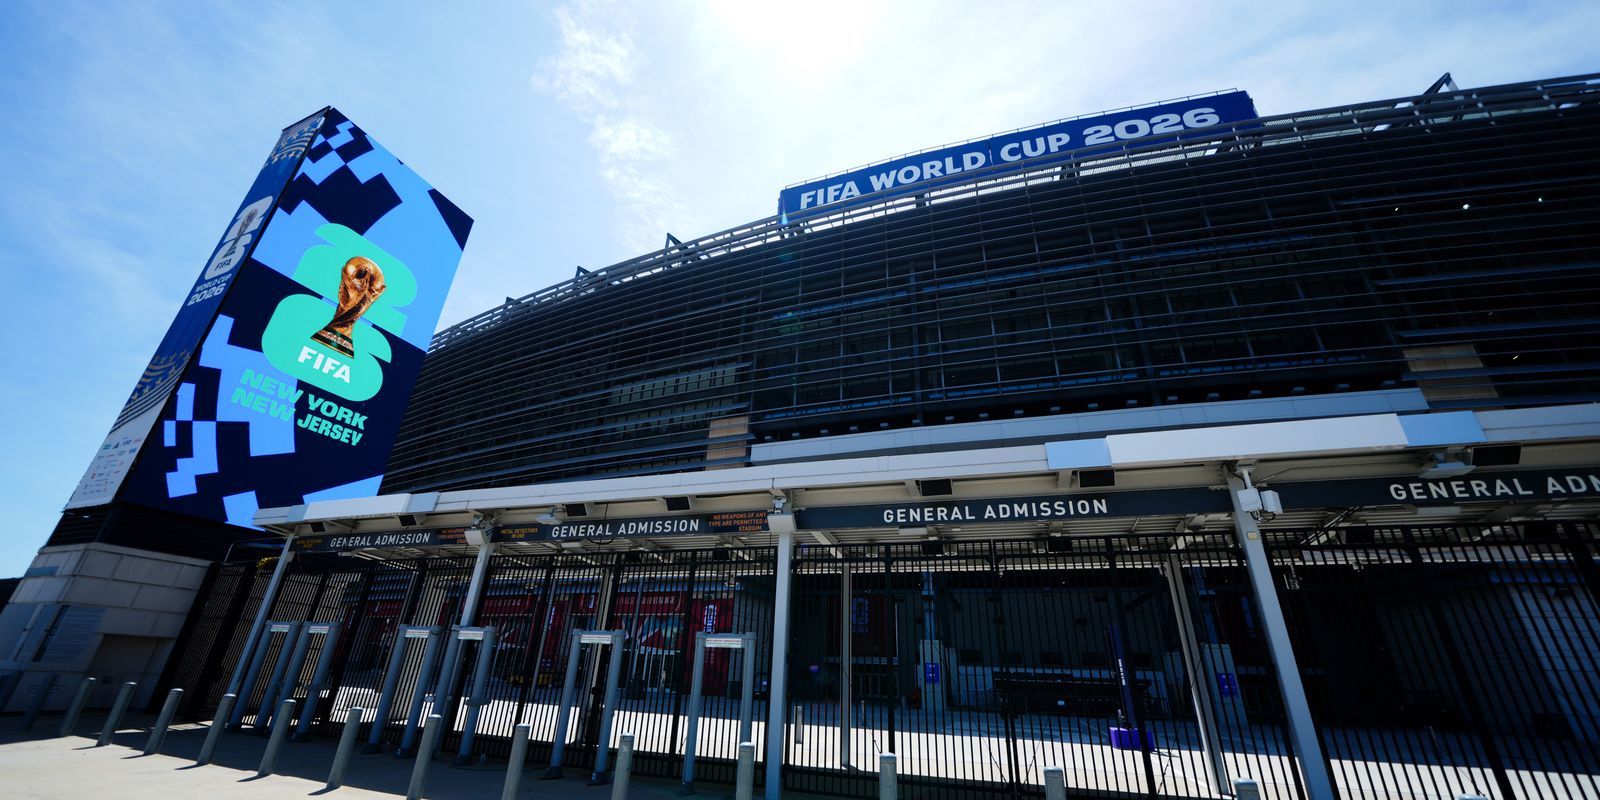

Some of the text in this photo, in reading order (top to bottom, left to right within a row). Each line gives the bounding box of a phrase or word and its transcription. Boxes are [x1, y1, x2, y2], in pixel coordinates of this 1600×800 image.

[799, 107, 1221, 210] FIFA WORLD CUP 2026
[214, 259, 232, 271] FIFA
[187, 283, 226, 306] 2026
[195, 273, 232, 293] WORLD CUP
[297, 345, 351, 384] FIFA
[240, 368, 369, 430] NEW YORK
[230, 387, 364, 447] NEW JERSEY
[1389, 478, 1534, 501] GENERAL
[883, 499, 1109, 523] GENERAL ADMISSION
[330, 535, 371, 548] GENERAL
[374, 531, 431, 546] ADMISSION
[551, 519, 700, 538] GENERAL ADMISSION
